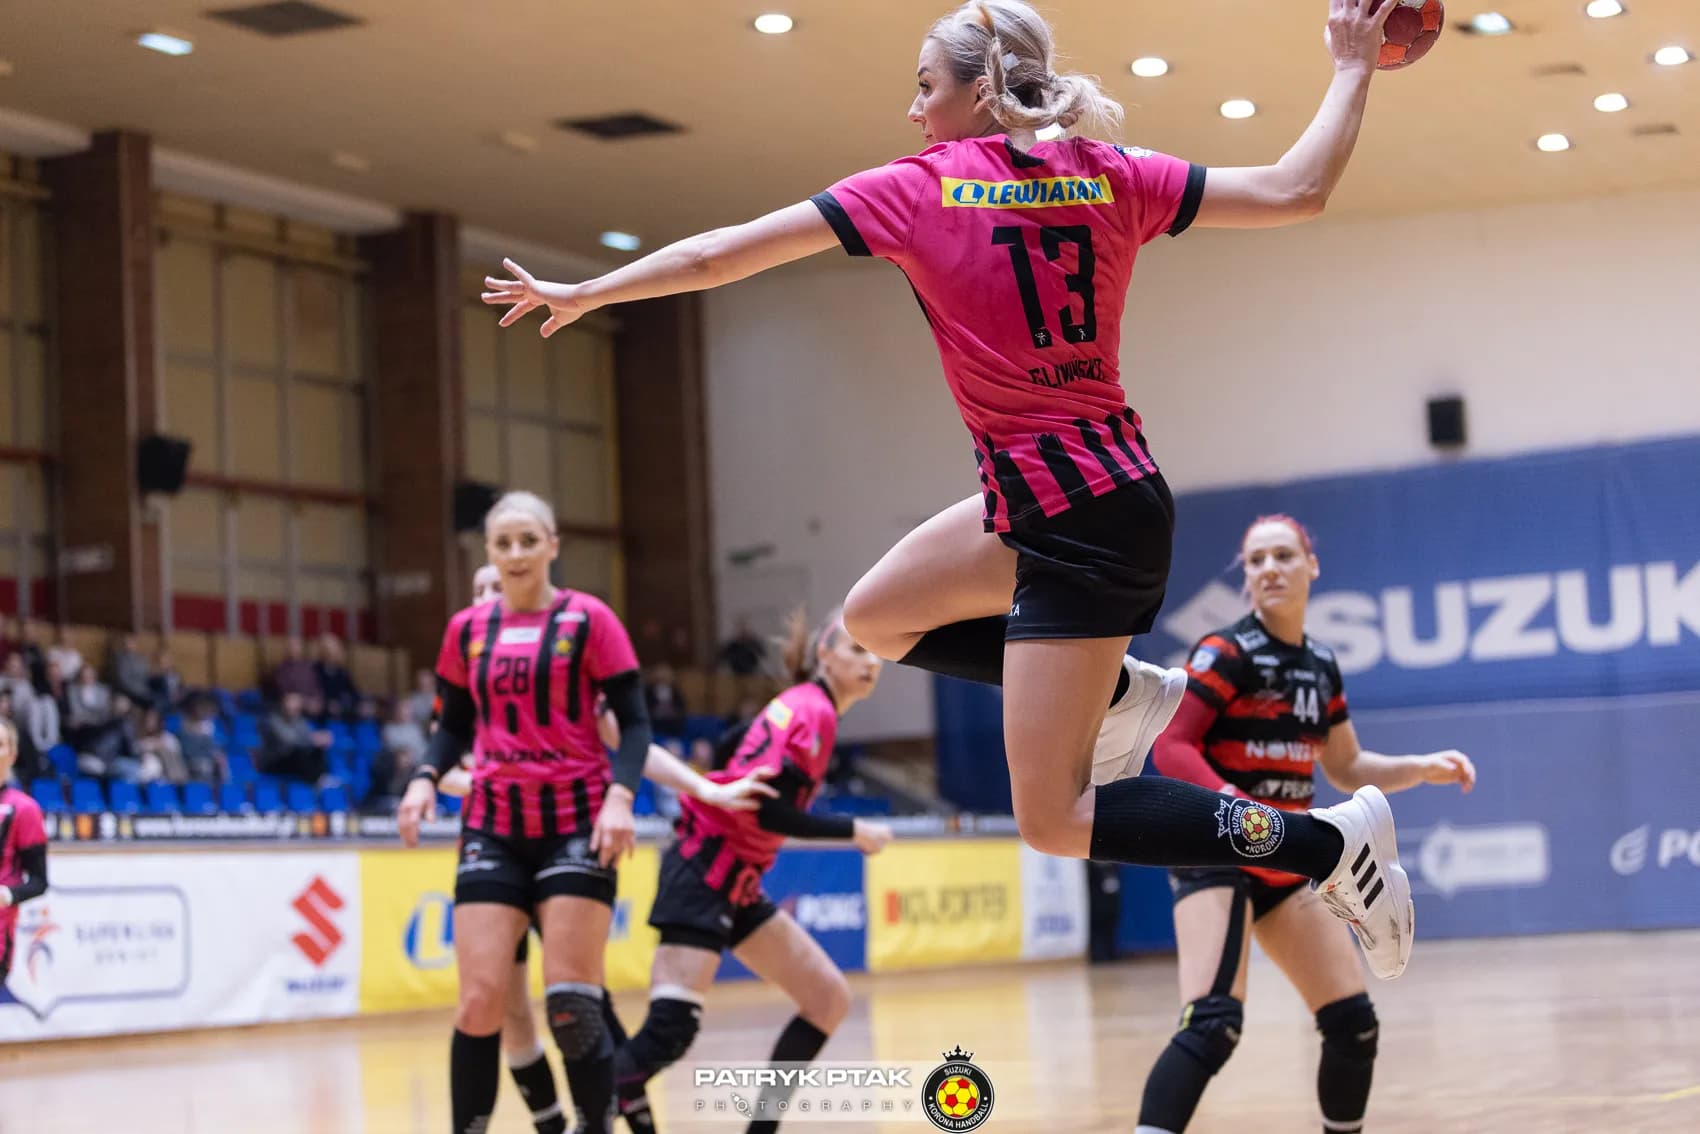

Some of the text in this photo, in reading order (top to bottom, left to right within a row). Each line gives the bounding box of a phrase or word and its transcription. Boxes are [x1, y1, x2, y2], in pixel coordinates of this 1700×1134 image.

[987, 179, 1104, 205] LEWIATAN
[991, 224, 1096, 349] 13
[493, 656, 532, 695] 28
[1293, 686, 1319, 724] 44
[1231, 804, 1243, 835] SUZUKI
[1249, 834, 1279, 854] KORONA
